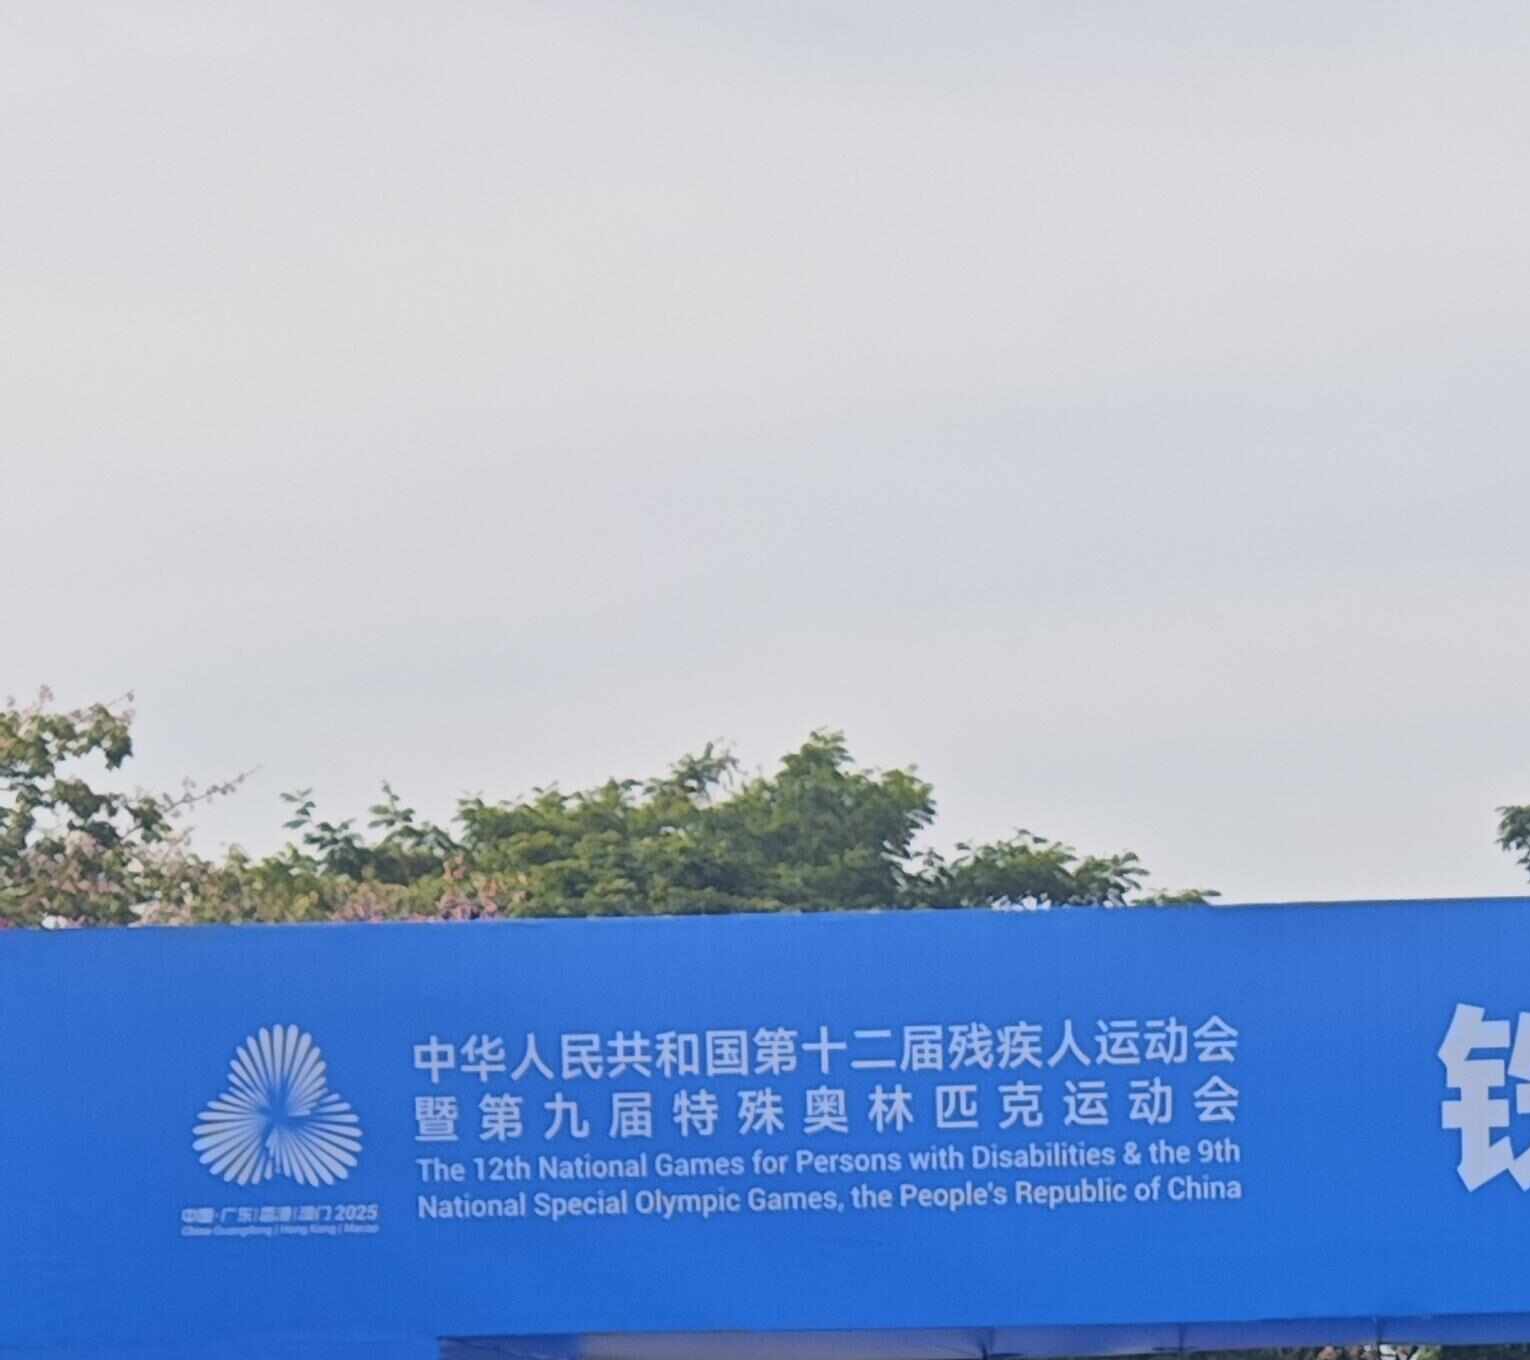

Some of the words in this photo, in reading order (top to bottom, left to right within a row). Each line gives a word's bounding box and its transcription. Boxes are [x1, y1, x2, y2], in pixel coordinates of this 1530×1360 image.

[413, 1015, 1239, 1084] 中华人民共和国第十二届残疾人运动会
[414, 1075, 1240, 1142] 暨第九届特殊奥林匹克运动会
[416, 1157, 466, 1183] The
[473, 1154, 531, 1182] 12th
[539, 1153, 648, 1180] National
[655, 1152, 745, 1178] Games
[752, 1149, 789, 1175] for
[796, 1149, 902, 1174] Persons
[908, 1145, 965, 1170] with
[972, 1141, 1115, 1169] Disabilities
[1123, 1140, 1142, 1165] &
[1148, 1140, 1191, 1166] the
[1197, 1137, 1241, 1163] 9th
[334, 1203, 379, 1222] 2025
[418, 1191, 527, 1219] National
[533, 1191, 627, 1222] Special
[635, 1188, 741, 1220] Olympic
[748, 1187, 846, 1214] Games,
[850, 1184, 893, 1209] the
[900, 1181, 1008, 1212] People's
[1015, 1178, 1128, 1210] Republic
[1134, 1175, 1162, 1200] of
[1167, 1174, 1242, 1201] China
